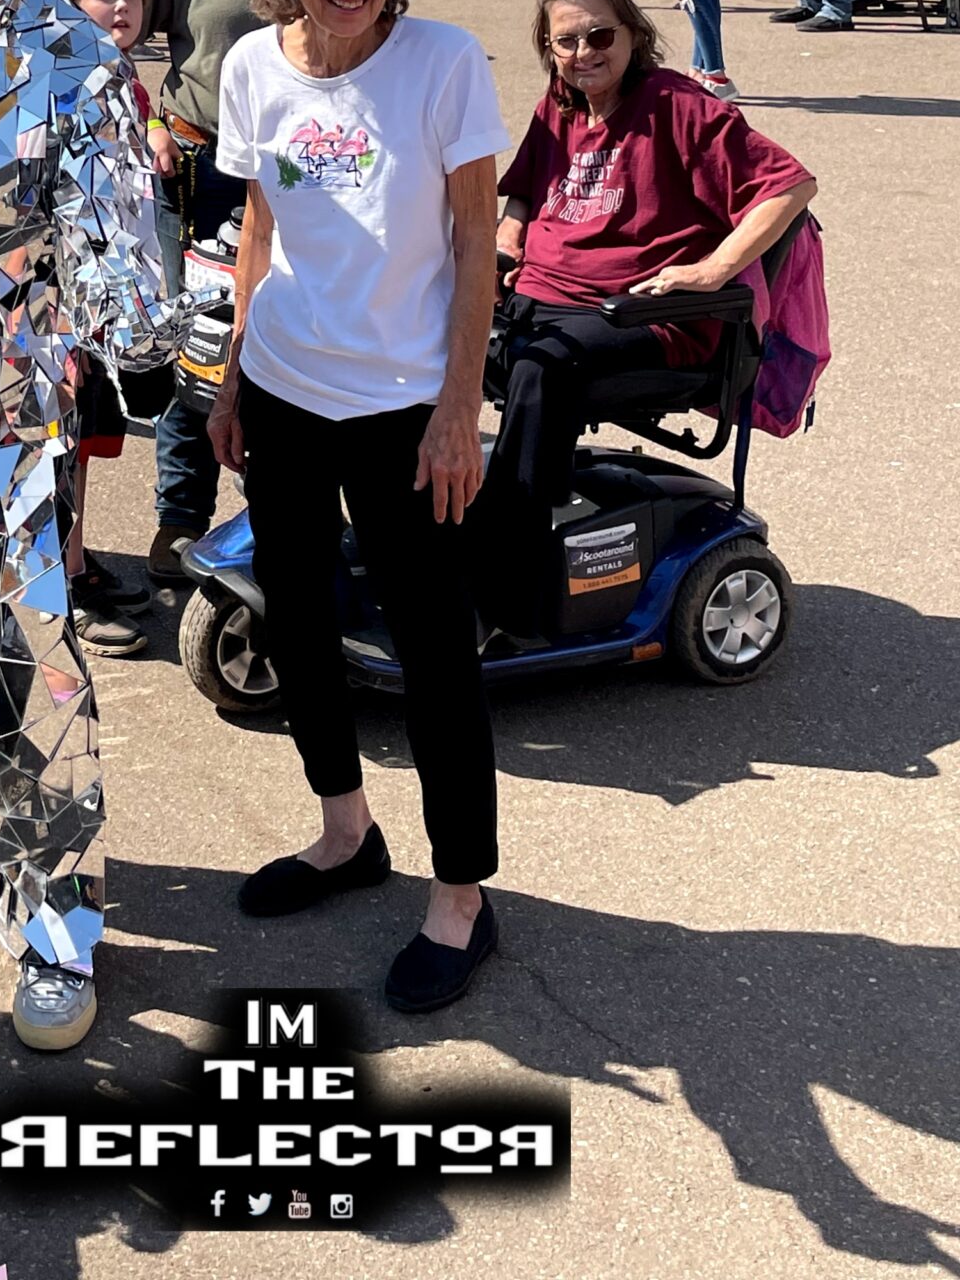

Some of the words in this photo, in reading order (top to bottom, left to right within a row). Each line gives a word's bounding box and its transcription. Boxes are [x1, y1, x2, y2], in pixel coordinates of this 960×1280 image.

[580, 167, 604, 183] NEED
[583, 541, 634, 562] Scootaround
[586, 561, 623, 574] RENTALS
